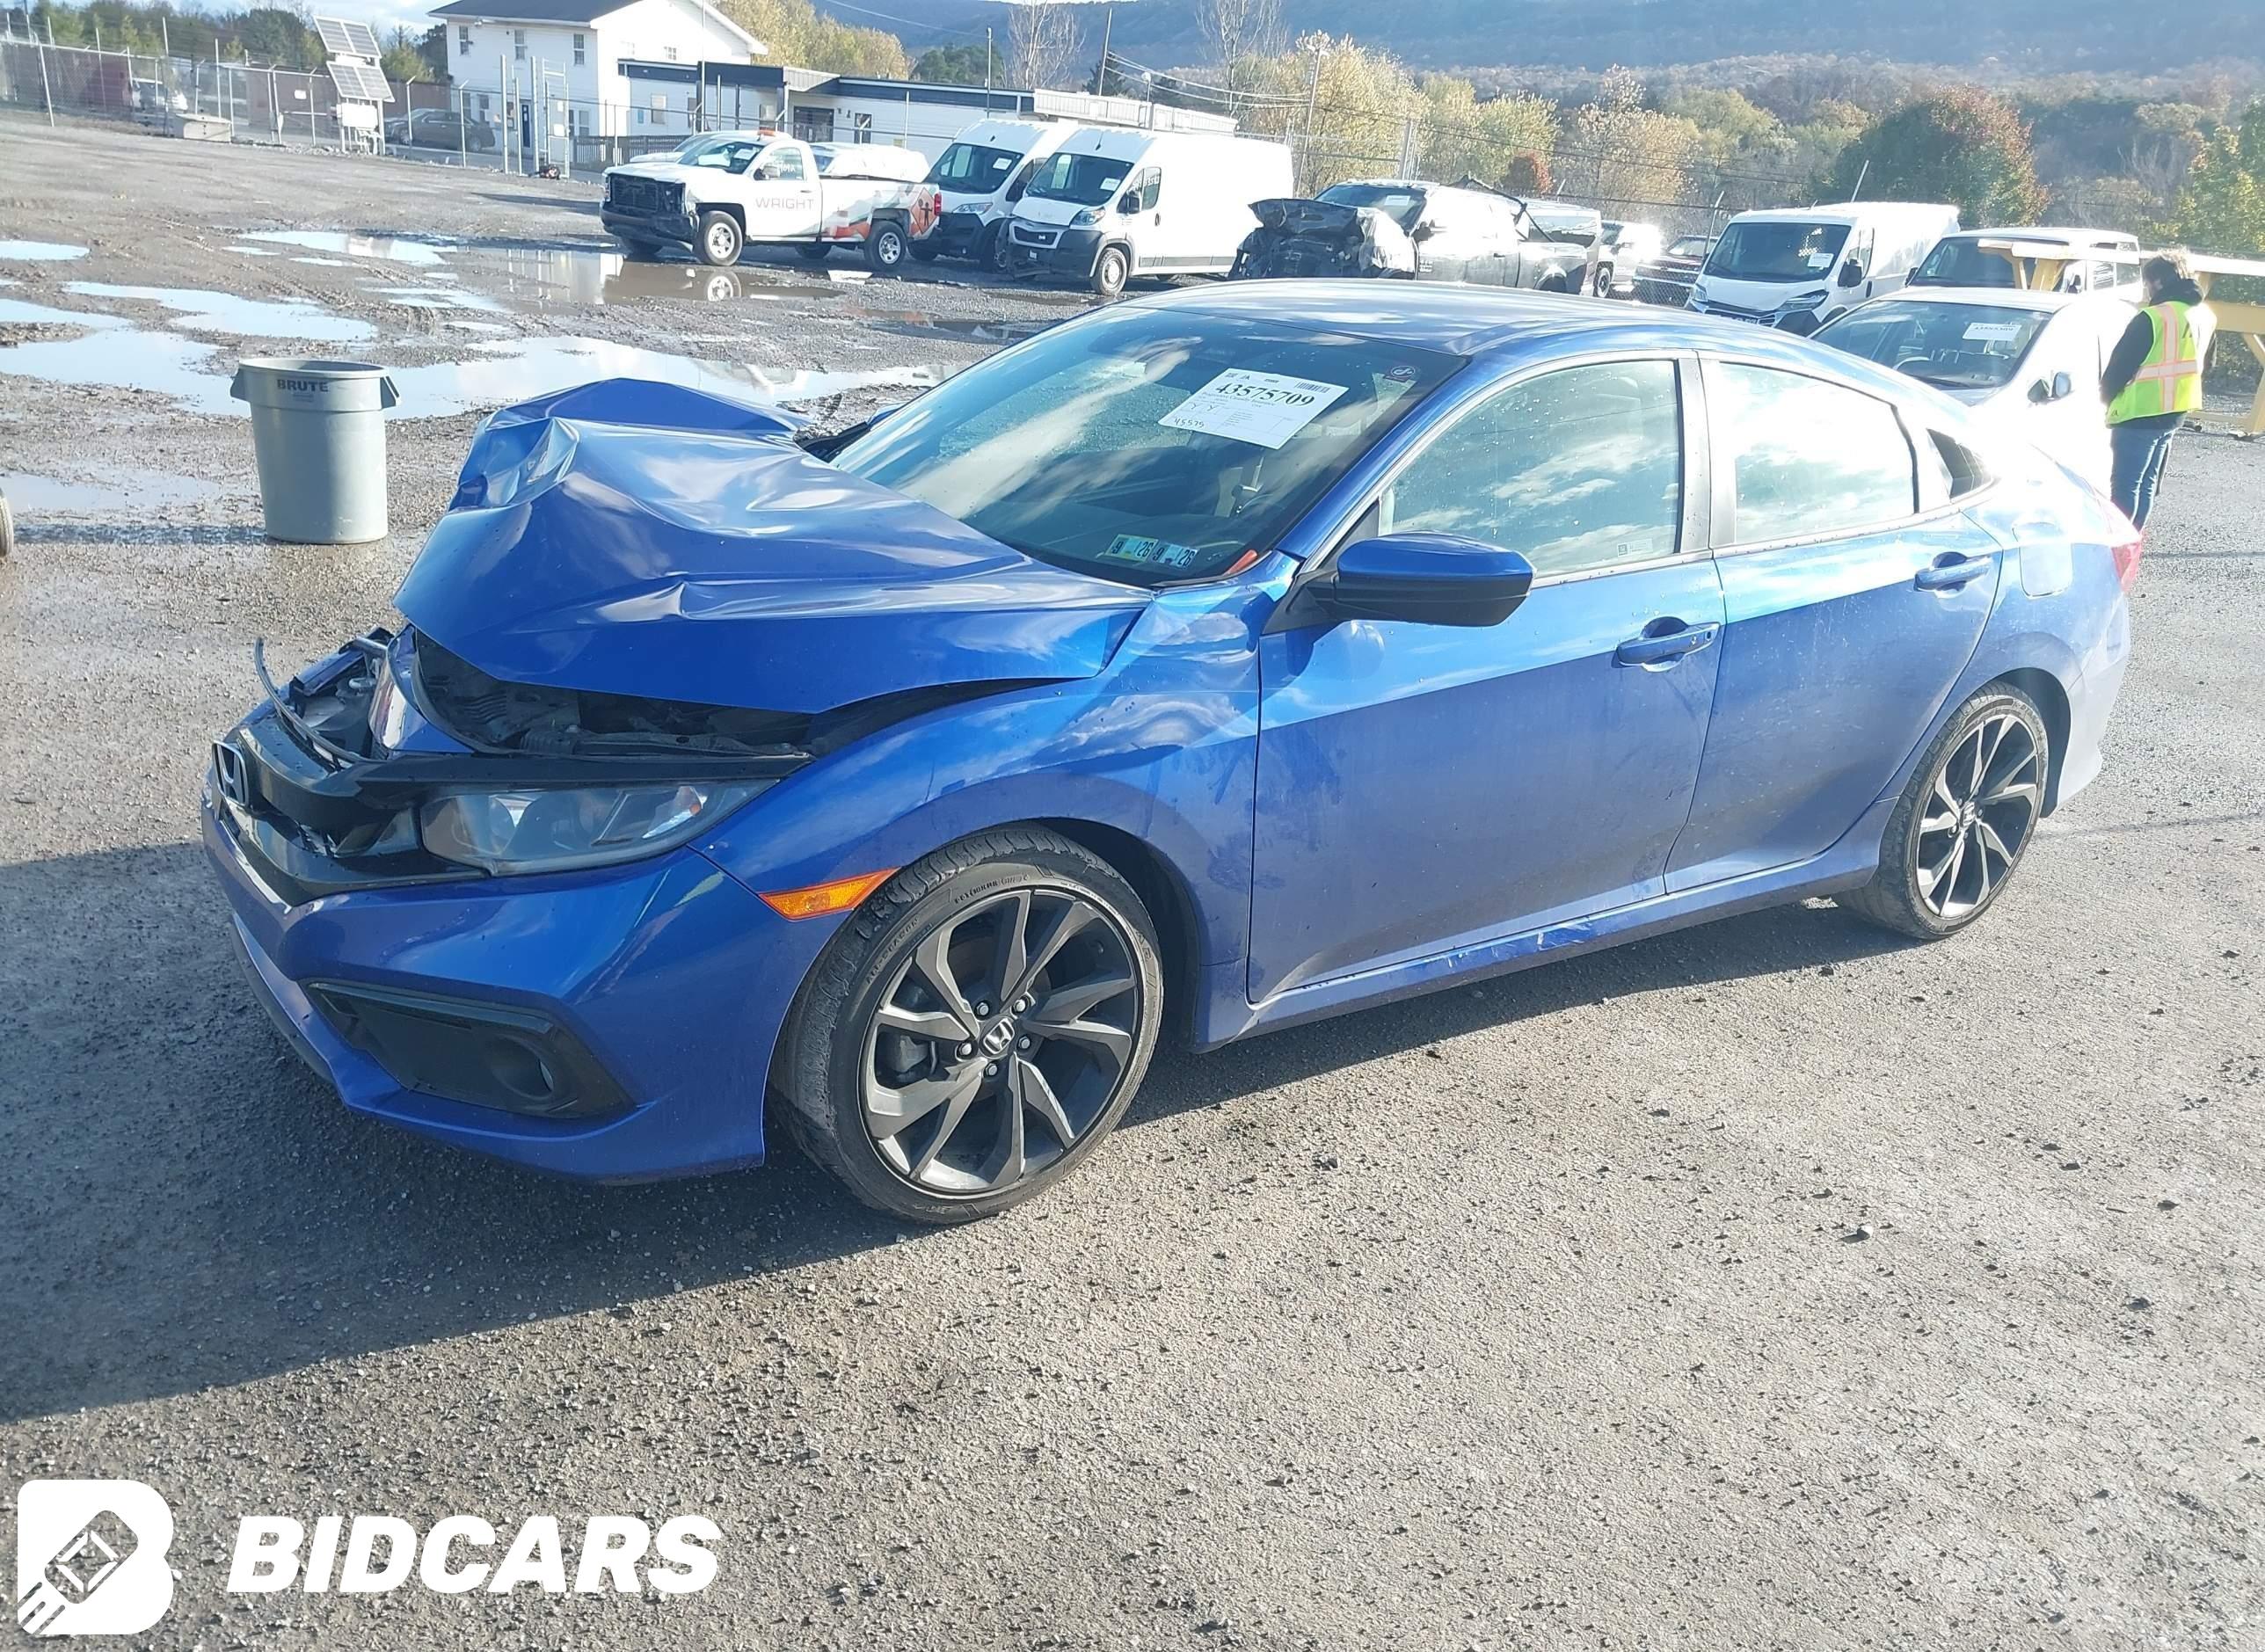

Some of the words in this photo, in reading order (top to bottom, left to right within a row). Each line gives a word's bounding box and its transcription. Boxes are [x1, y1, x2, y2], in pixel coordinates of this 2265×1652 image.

[755, 196, 814, 210] WRIGHT
[276, 378, 329, 392] BRUTE
[1215, 382, 1315, 407] 43575709
